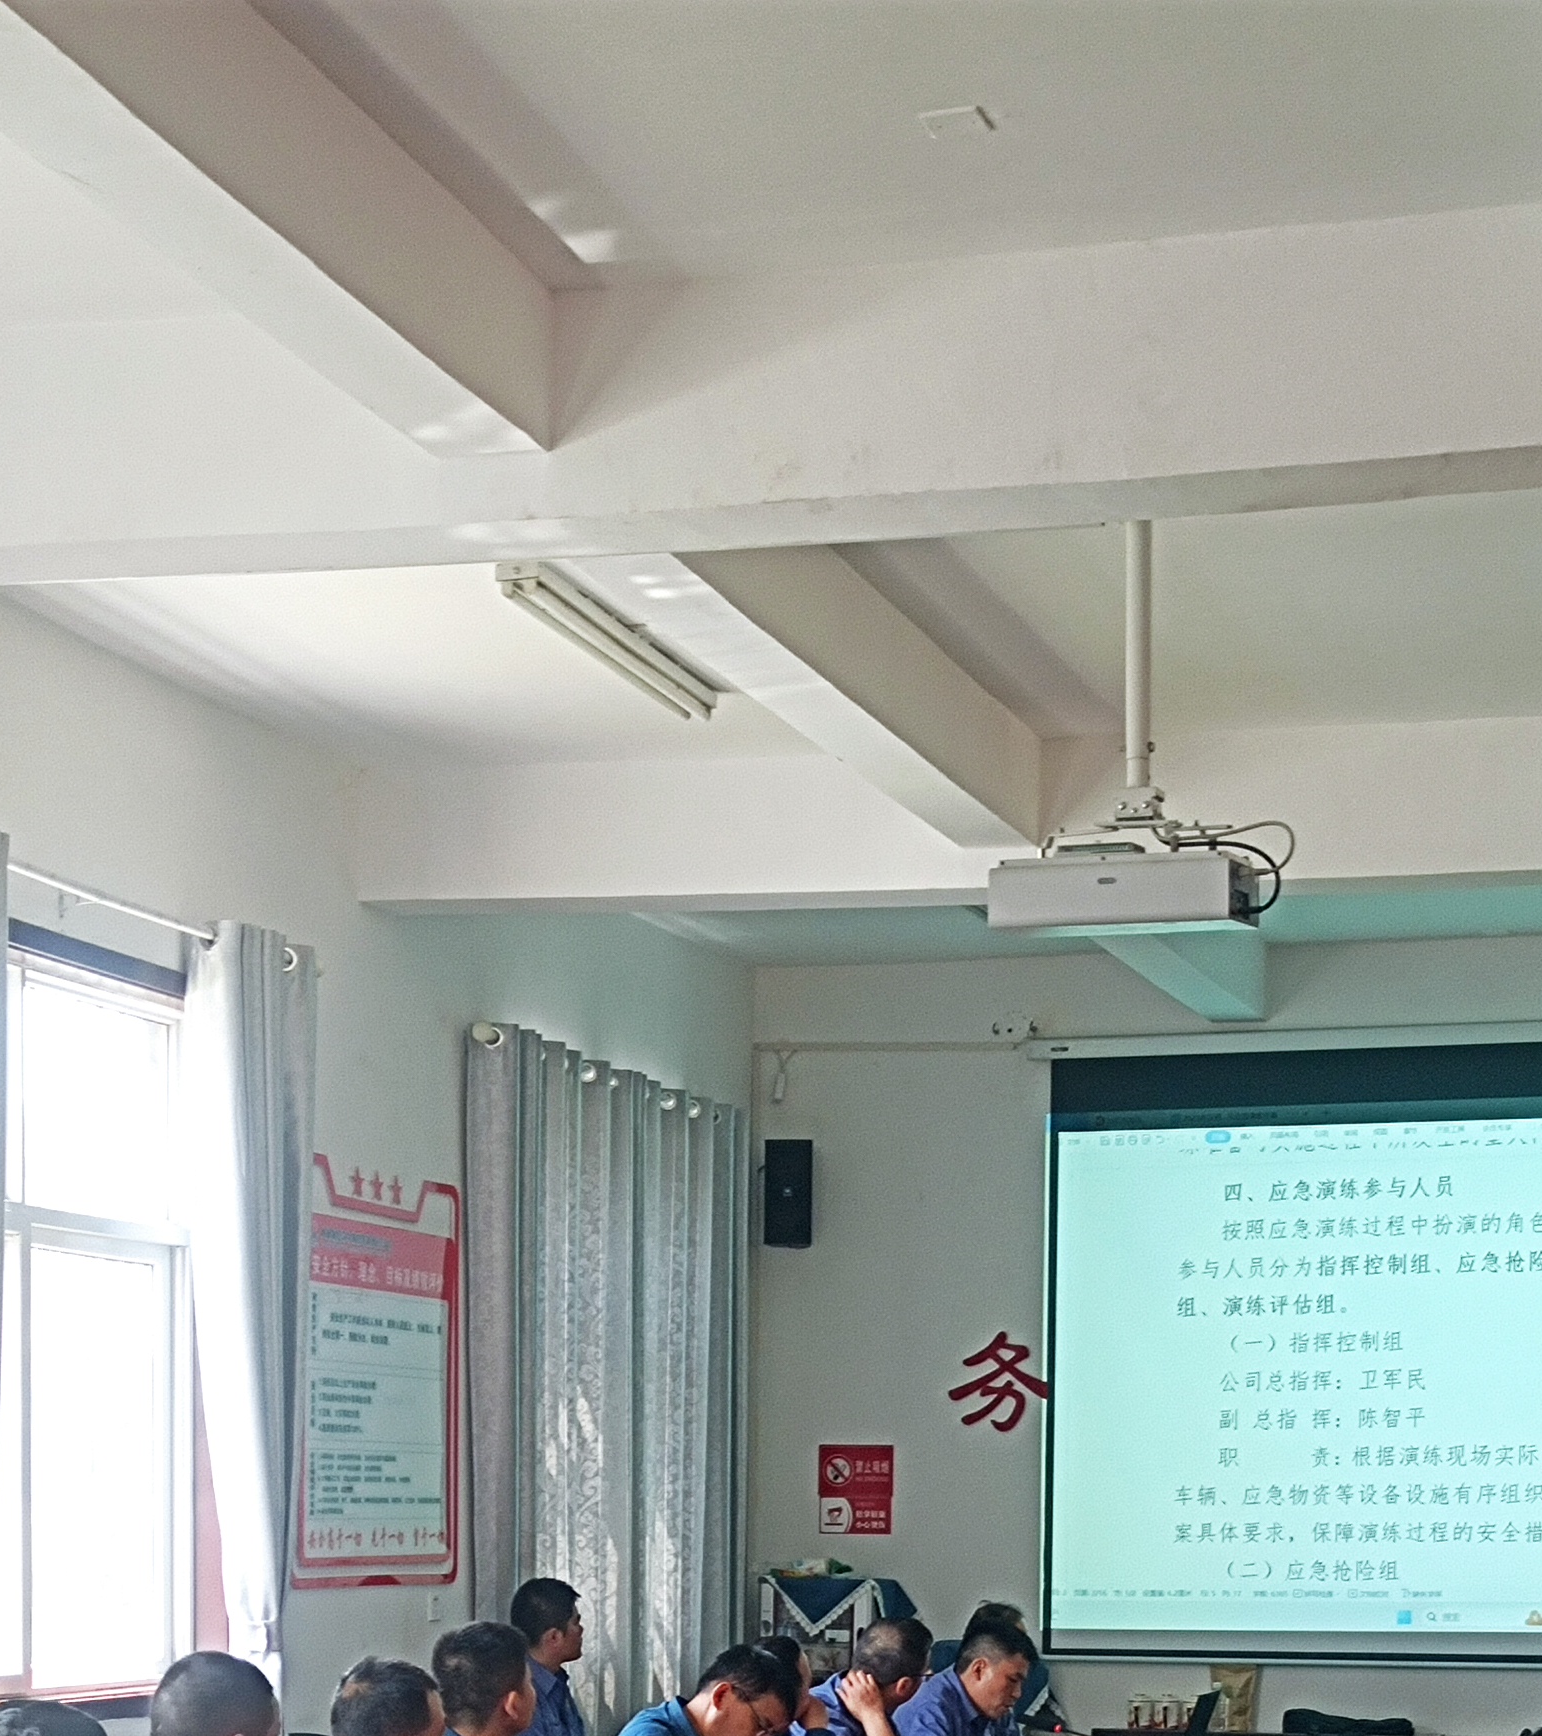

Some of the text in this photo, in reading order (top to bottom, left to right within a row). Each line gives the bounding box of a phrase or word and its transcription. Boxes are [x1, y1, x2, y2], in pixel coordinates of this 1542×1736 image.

[1222, 1174, 1455, 1203] 四、应急演练参与人员
[948, 1331, 1048, 1432] 务
